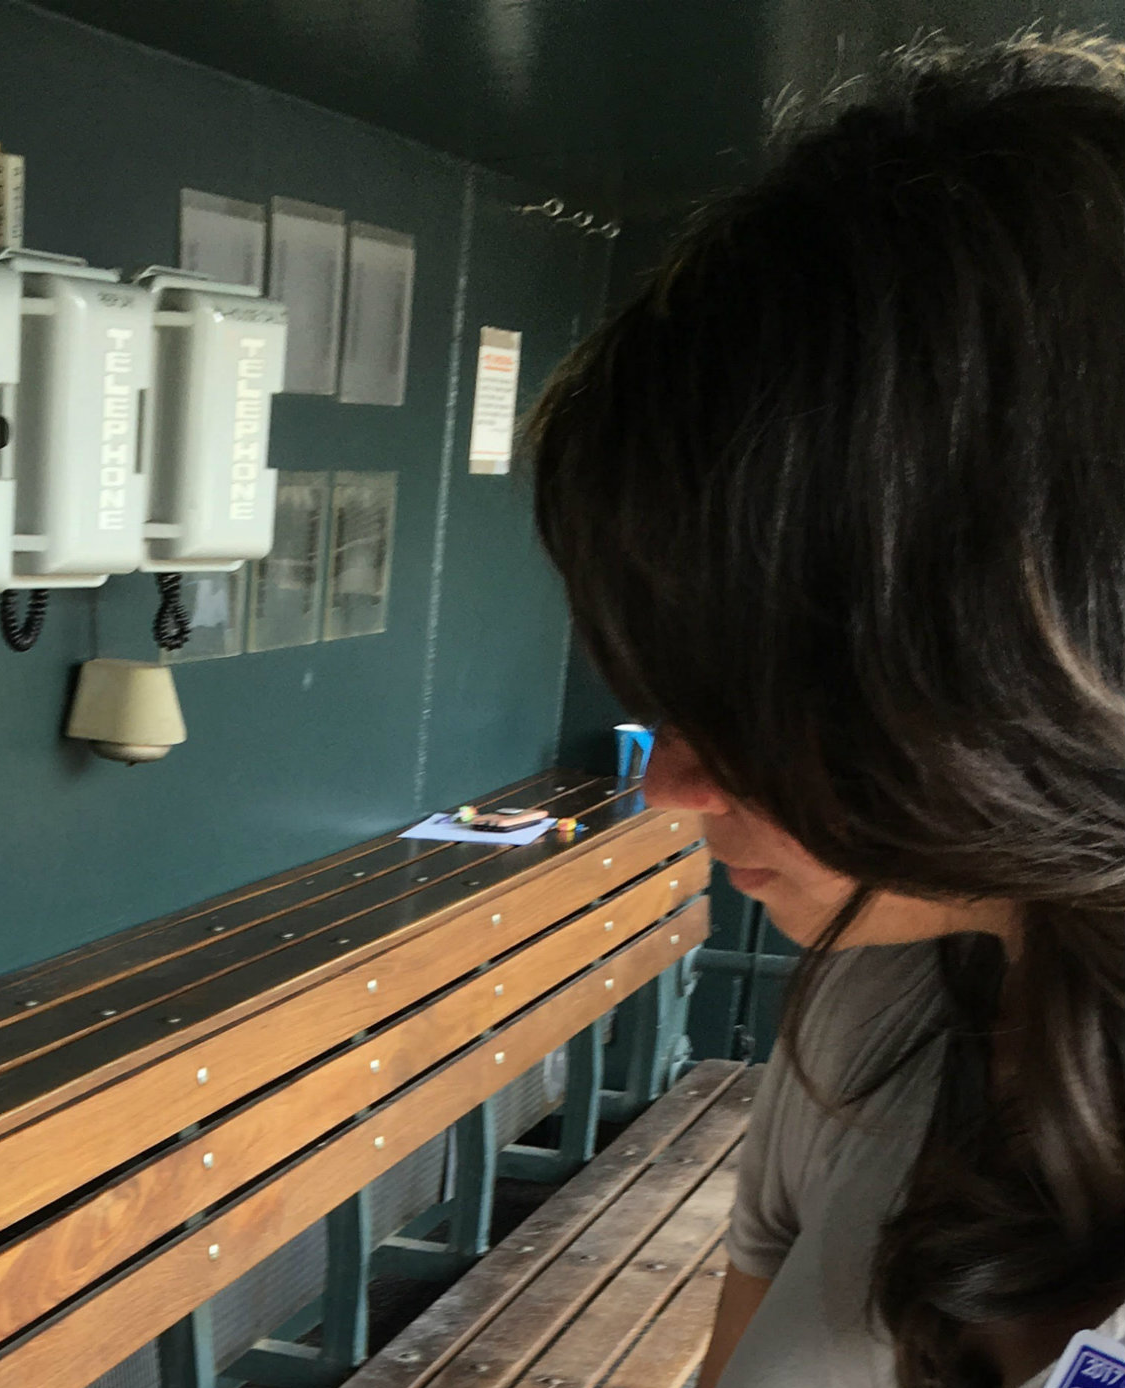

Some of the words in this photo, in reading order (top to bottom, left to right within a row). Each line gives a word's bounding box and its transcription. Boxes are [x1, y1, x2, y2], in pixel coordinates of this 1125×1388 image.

[98, 327, 133, 531] TELEPHONE
[229, 337, 267, 521] TELEPHONE
[1081, 1356, 1125, 1386] 2017
